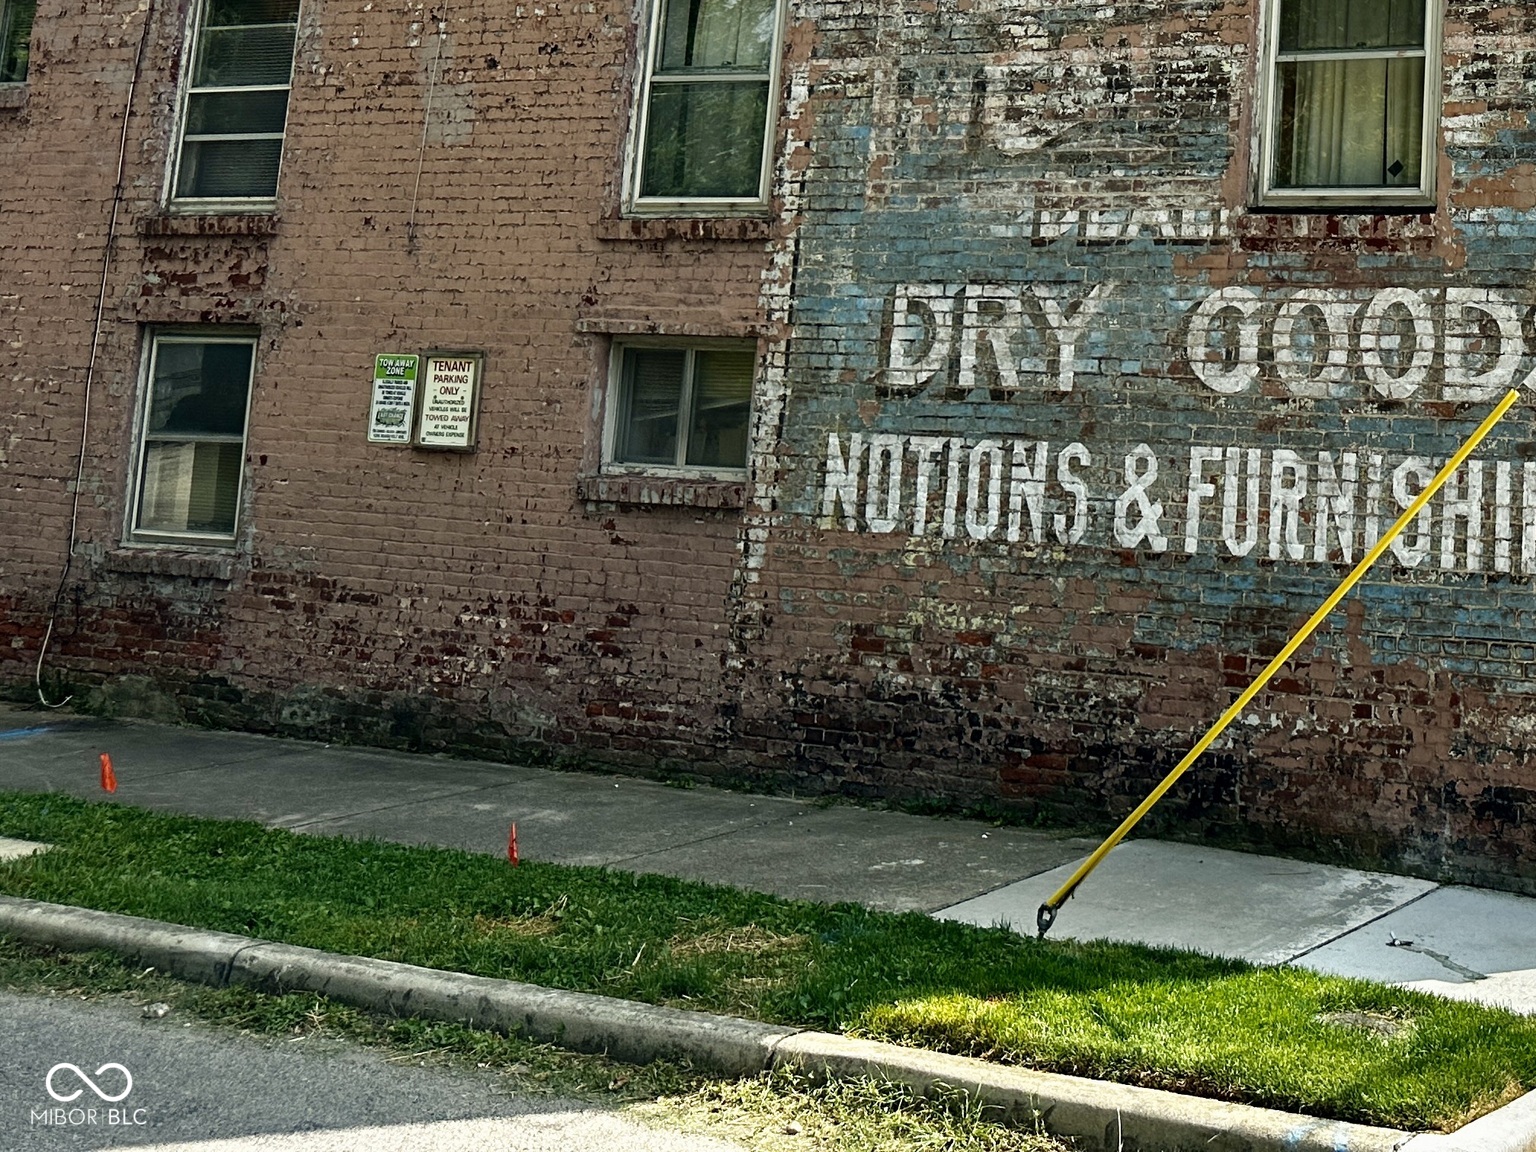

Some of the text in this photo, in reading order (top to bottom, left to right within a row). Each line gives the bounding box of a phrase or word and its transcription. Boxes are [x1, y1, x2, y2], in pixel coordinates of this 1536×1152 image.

[888, 284, 1113, 392] DRY
[379, 358, 415, 368] TOW AWAY
[433, 360, 472, 373] TENANT
[386, 367, 405, 375] ZONE
[433, 374, 468, 384] PARKING
[439, 386, 460, 395] ONLY
[425, 414, 469, 423] TOWED AWAY
[820, 431, 1091, 546] NOTIONS
[1112, 443, 1168, 553] &
